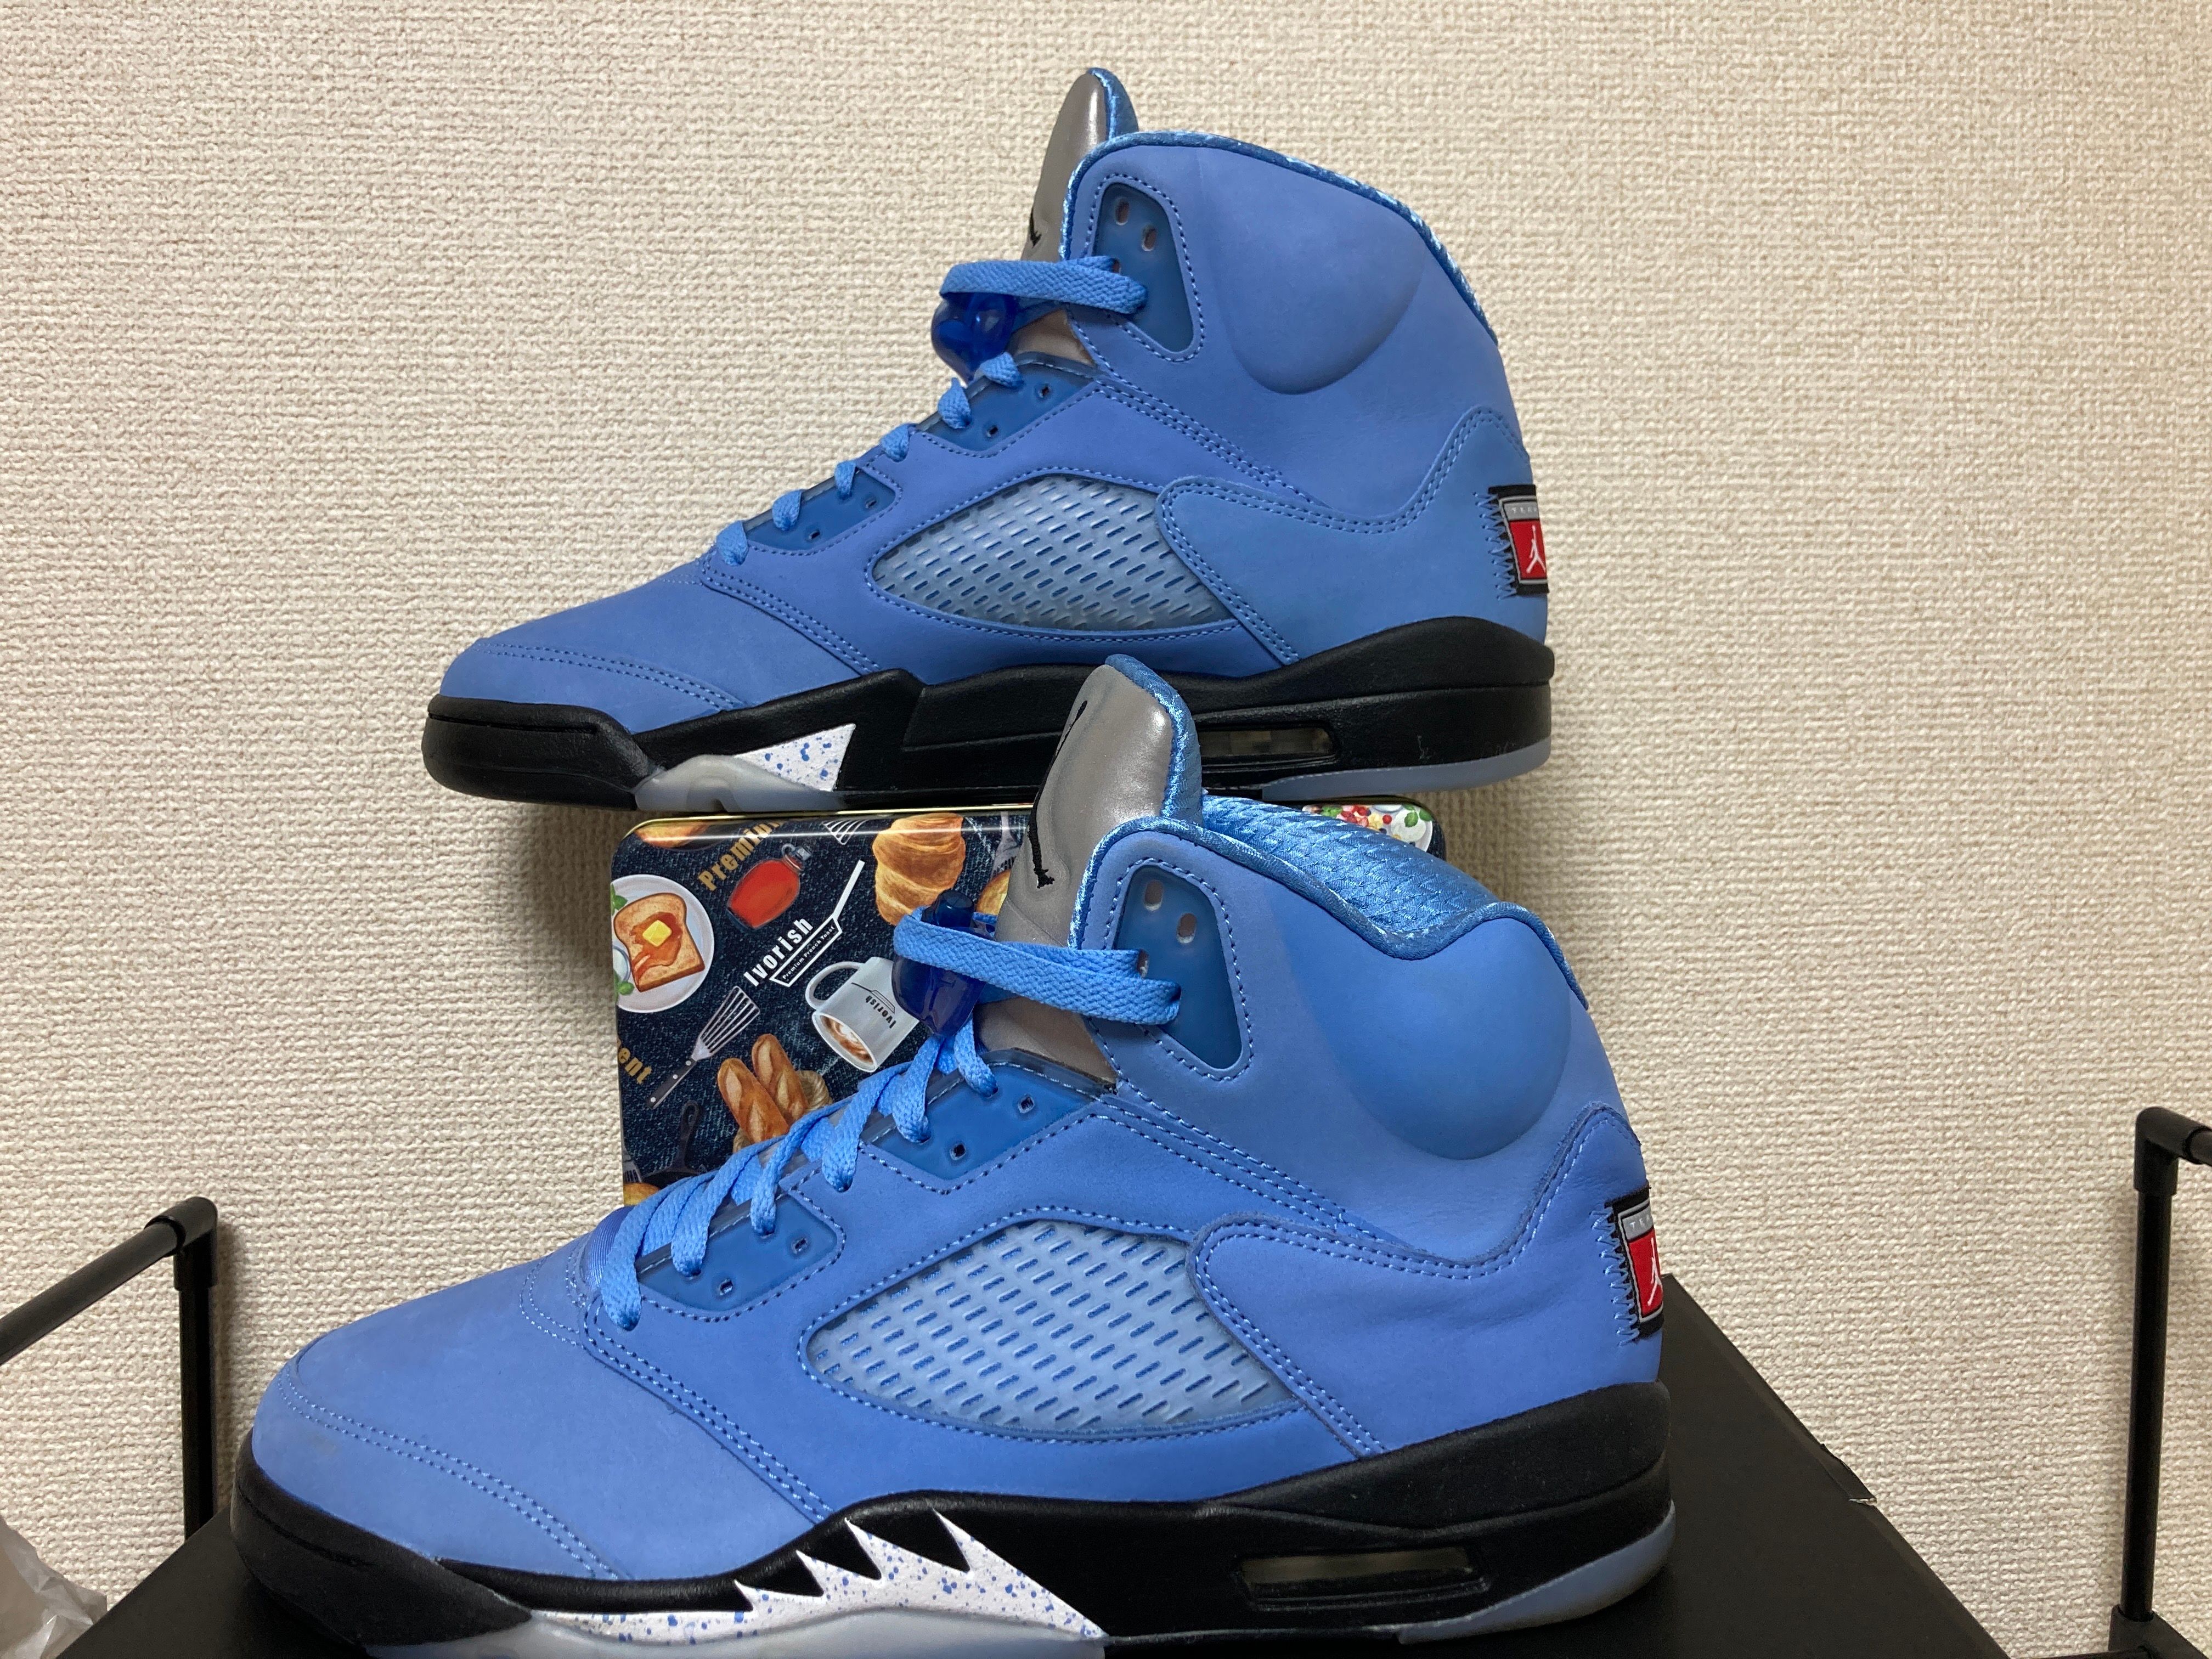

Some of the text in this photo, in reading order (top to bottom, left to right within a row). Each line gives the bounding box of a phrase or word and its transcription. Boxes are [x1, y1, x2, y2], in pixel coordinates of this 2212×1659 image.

[743, 918, 814, 986] Ivorish
[804, 938, 822, 958] French
[866, 995, 896, 1029] Ivorish
